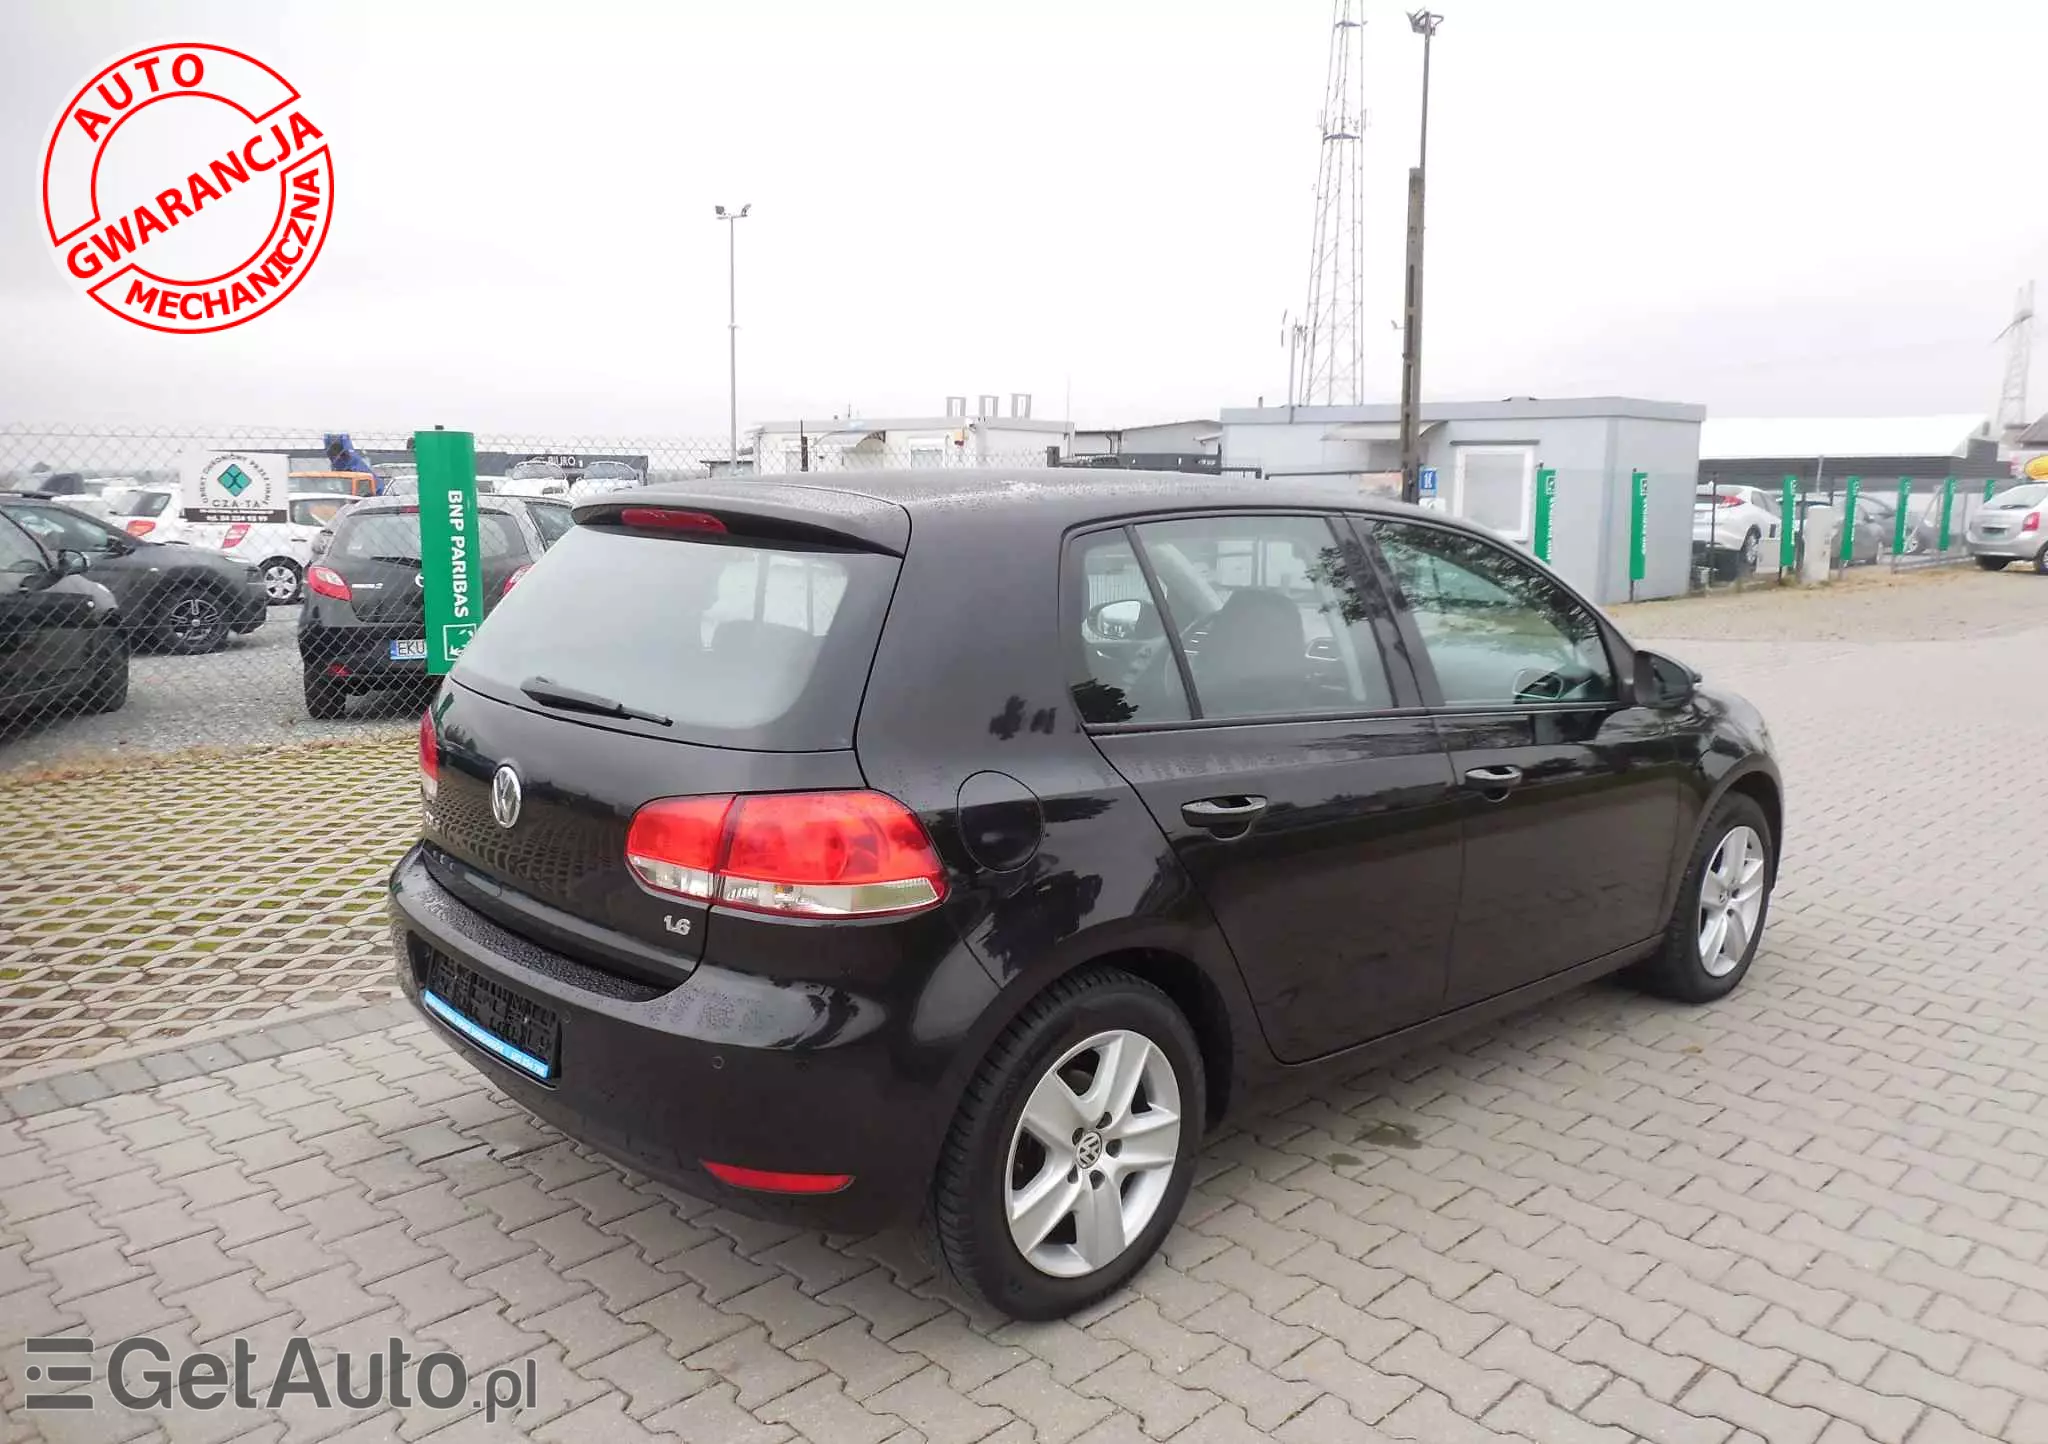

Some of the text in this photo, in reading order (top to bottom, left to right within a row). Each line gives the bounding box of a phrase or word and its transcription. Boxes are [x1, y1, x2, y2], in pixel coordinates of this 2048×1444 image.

[448, 490, 469, 619] BNP PARIBAS
[398, 640, 425, 655] EKU
[663, 914, 691, 936] 1.6
